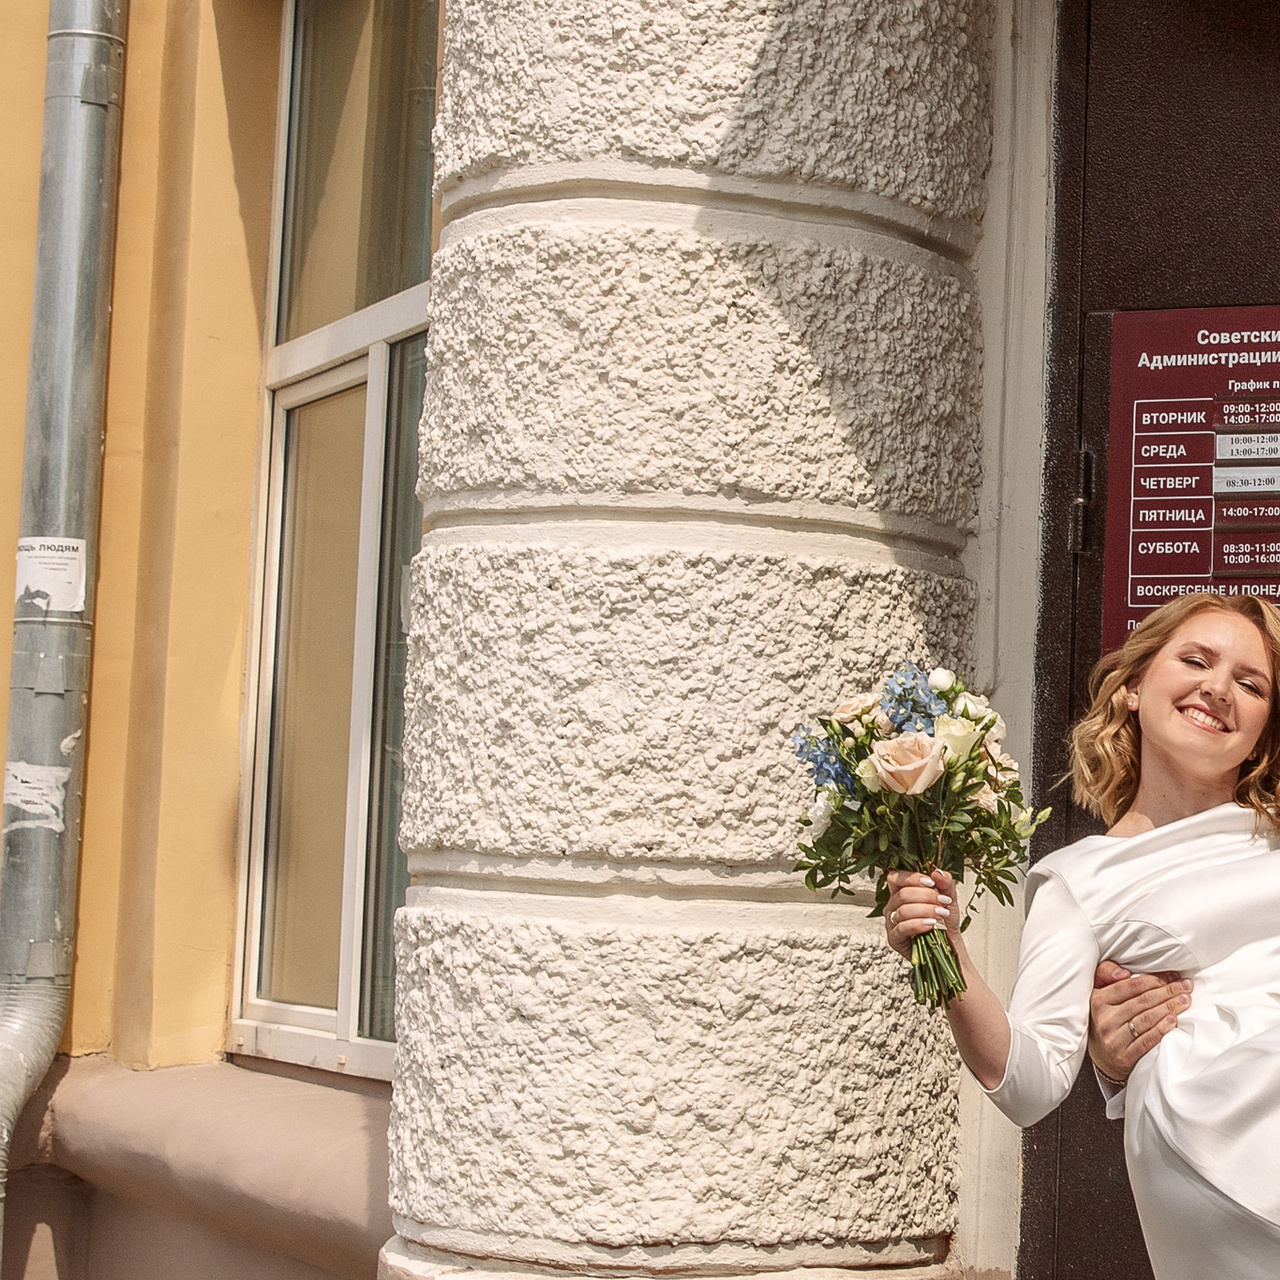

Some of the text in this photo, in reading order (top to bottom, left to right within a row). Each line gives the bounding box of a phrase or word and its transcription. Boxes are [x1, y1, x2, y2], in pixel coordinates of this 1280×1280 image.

[1228, 379, 1270, 392] График
[1142, 411, 1207, 425] ВТОРНИК
[1230, 435, 1279, 445] 10:00-12:00
[1141, 444, 1187, 459] СРЕДА
[1230, 446, 1279, 457] 13:00-17:00
[1140, 476, 1200, 490] ЧЕТВЕРГ
[1225, 477, 1276, 488] 08:30-12:00
[1139, 509, 1206, 523] ПЯТНИЦА
[1222, 506, 1280, 517] 14:00-17:00
[39, 544, 79, 553] ЛЮДЯМ
[1138, 541, 1200, 554] СУББОТА
[1137, 584, 1226, 596] ВОСКРЕСЕНЬЕ
[1229, 584, 1238, 596] И
